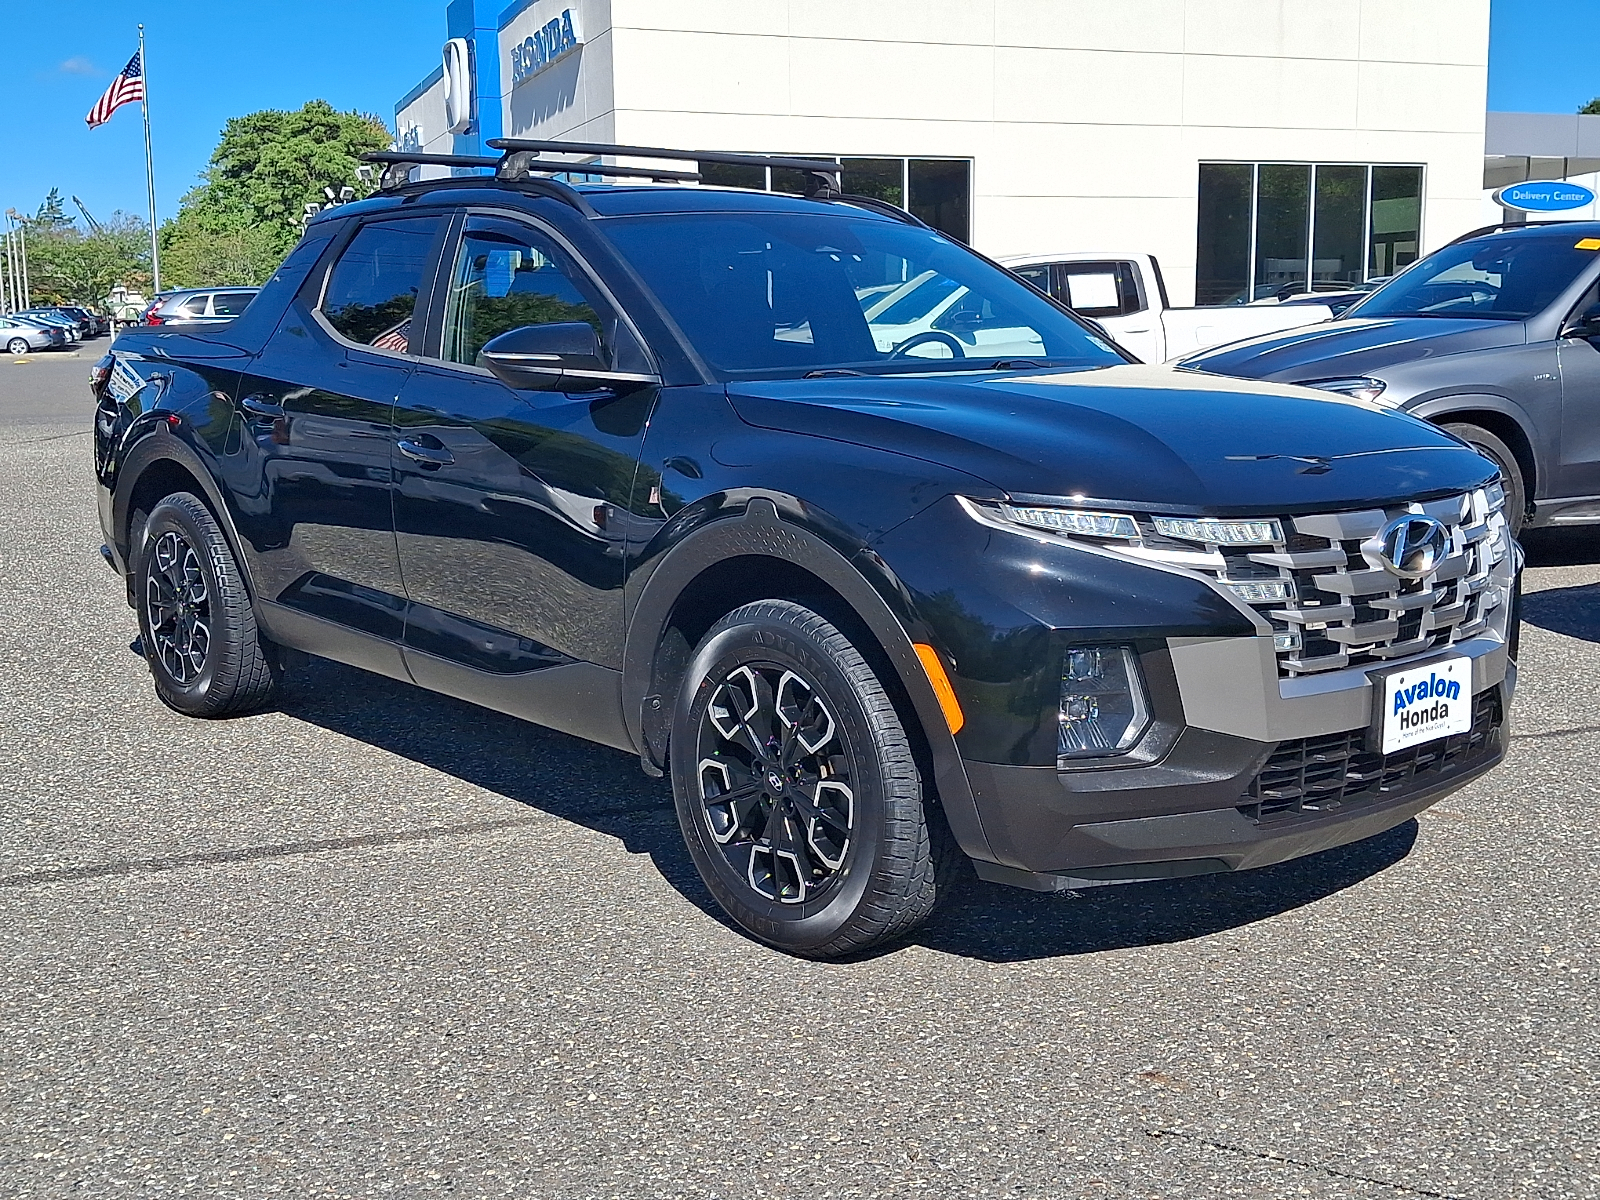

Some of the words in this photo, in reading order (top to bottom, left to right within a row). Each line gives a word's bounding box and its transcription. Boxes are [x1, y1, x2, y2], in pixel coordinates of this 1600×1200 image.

[510, 8, 578, 83] HONDA
[1512, 190, 1551, 202] Delivery
[1553, 191, 1585, 201] Center
[1393, 672, 1461, 717] Avalon
[1400, 699, 1449, 731] Honda
